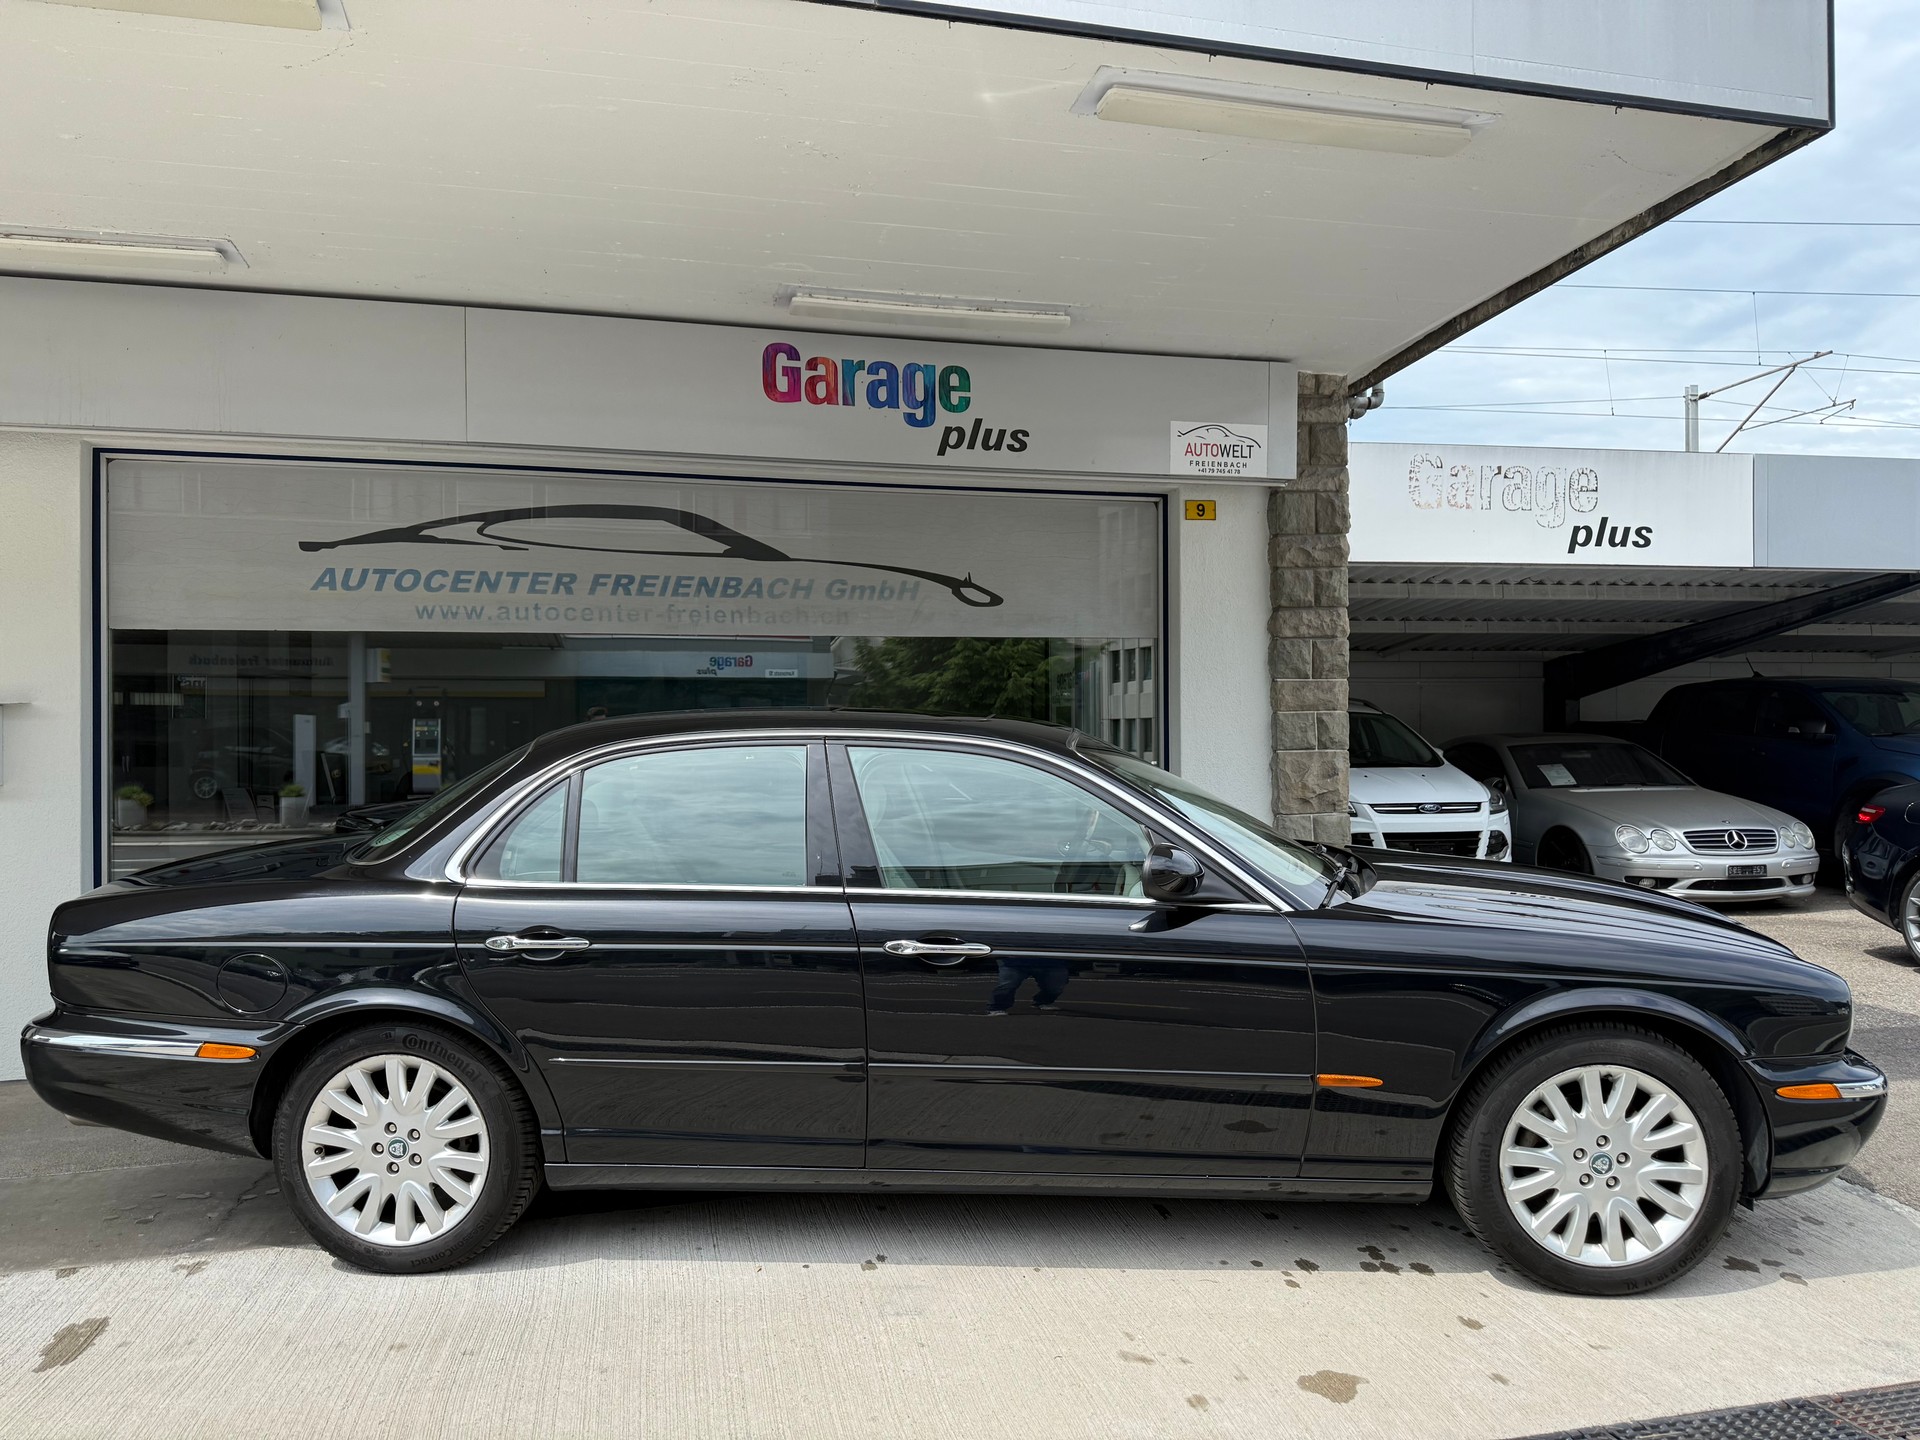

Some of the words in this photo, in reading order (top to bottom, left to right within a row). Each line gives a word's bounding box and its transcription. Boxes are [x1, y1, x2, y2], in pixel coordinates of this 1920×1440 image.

[762, 342, 972, 428] Garage
[936, 417, 1031, 457] plus
[1184, 443, 1254, 458] AUTOWELT
[1189, 460, 1248, 469] FREIENBACH
[1408, 452, 1599, 529] Garage
[1196, 503, 1206, 518] 9
[1567, 516, 1654, 554] plus
[310, 567, 578, 596] AUTOCENTER
[587, 573, 815, 600] FREIENBACH
[824, 578, 921, 602] GmbH
[402, 1033, 481, 1082] Continental
